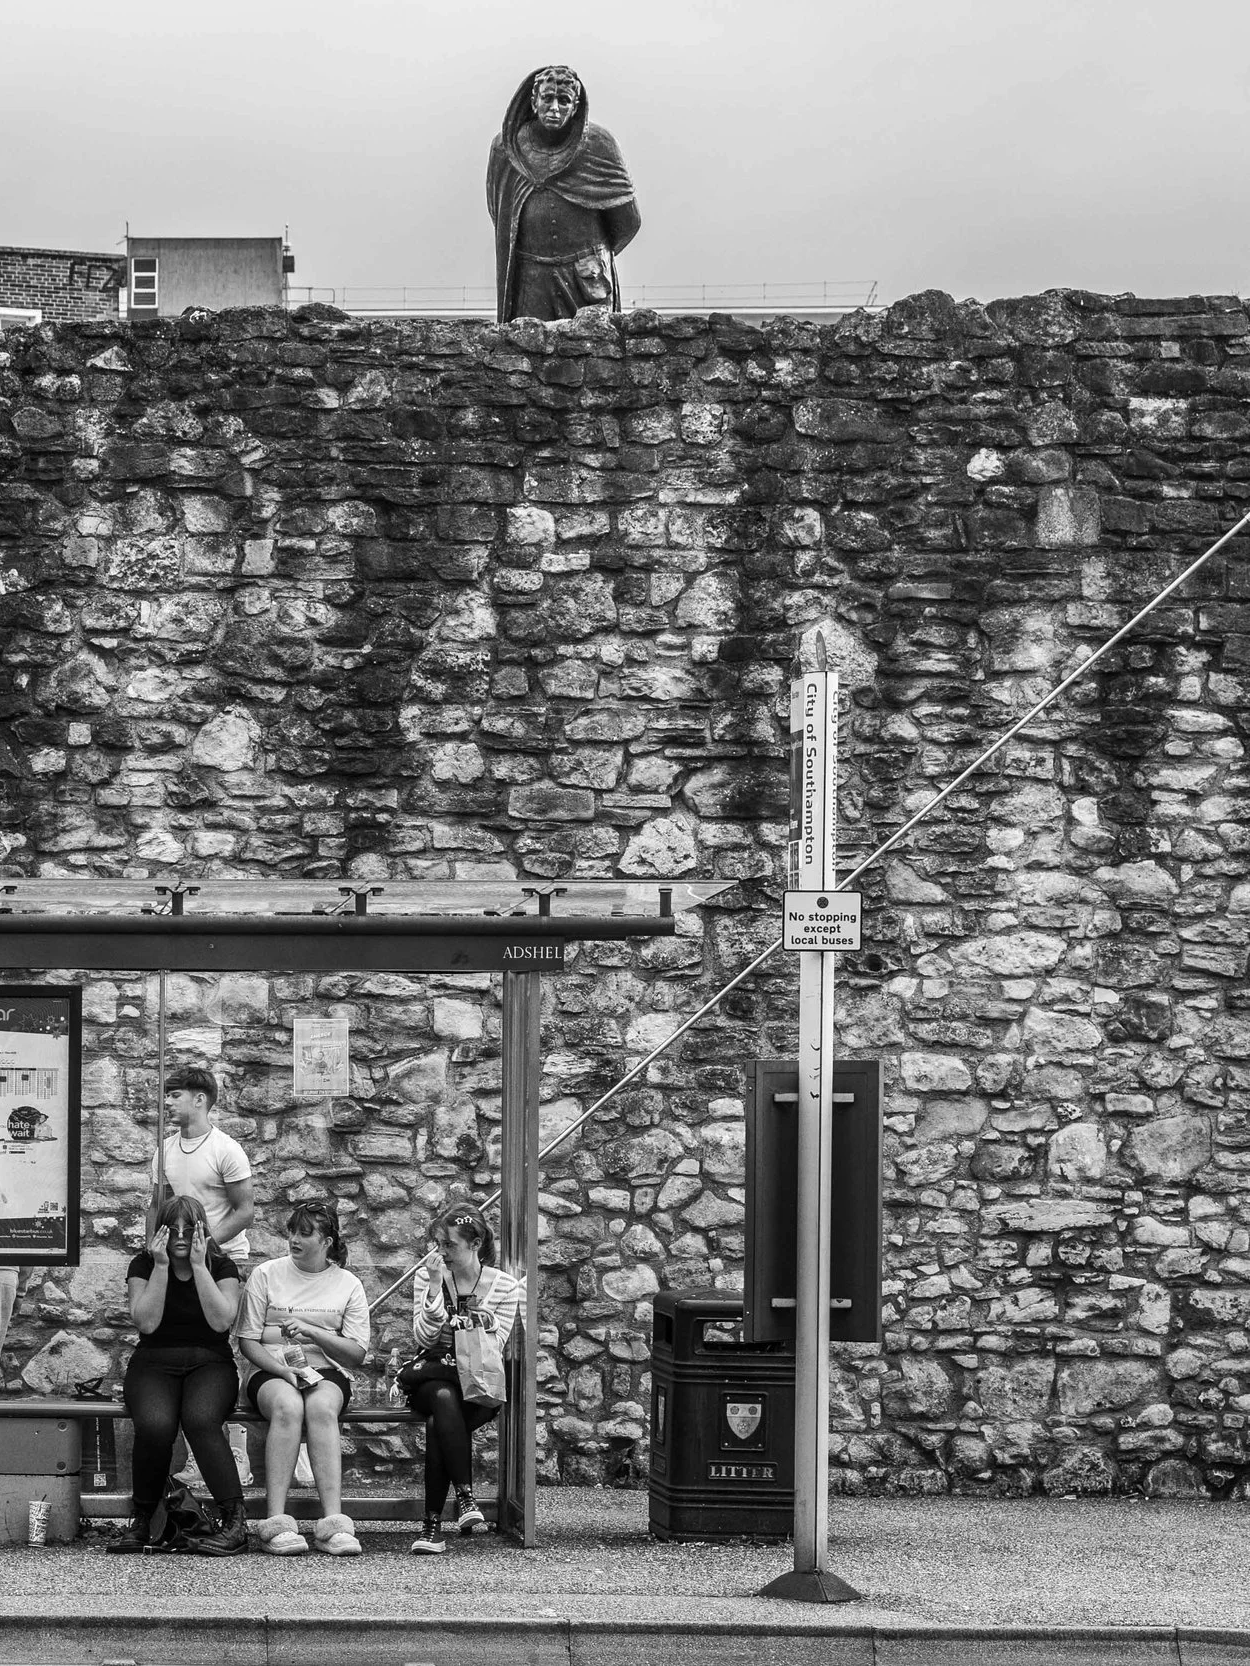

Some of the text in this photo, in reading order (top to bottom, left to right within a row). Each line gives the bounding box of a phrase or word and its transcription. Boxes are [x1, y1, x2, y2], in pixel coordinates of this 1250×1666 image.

[804, 683, 817, 865] City of Southampton
[789, 912, 857, 924] No stopping
[803, 924, 841, 934] except
[791, 935, 854, 945] local buses
[502, 946, 563, 959] ADSHEL
[8, 1119, 30, 1129] hate
[10, 1128, 30, 1137] wait
[710, 1465, 774, 1478] LITTER
